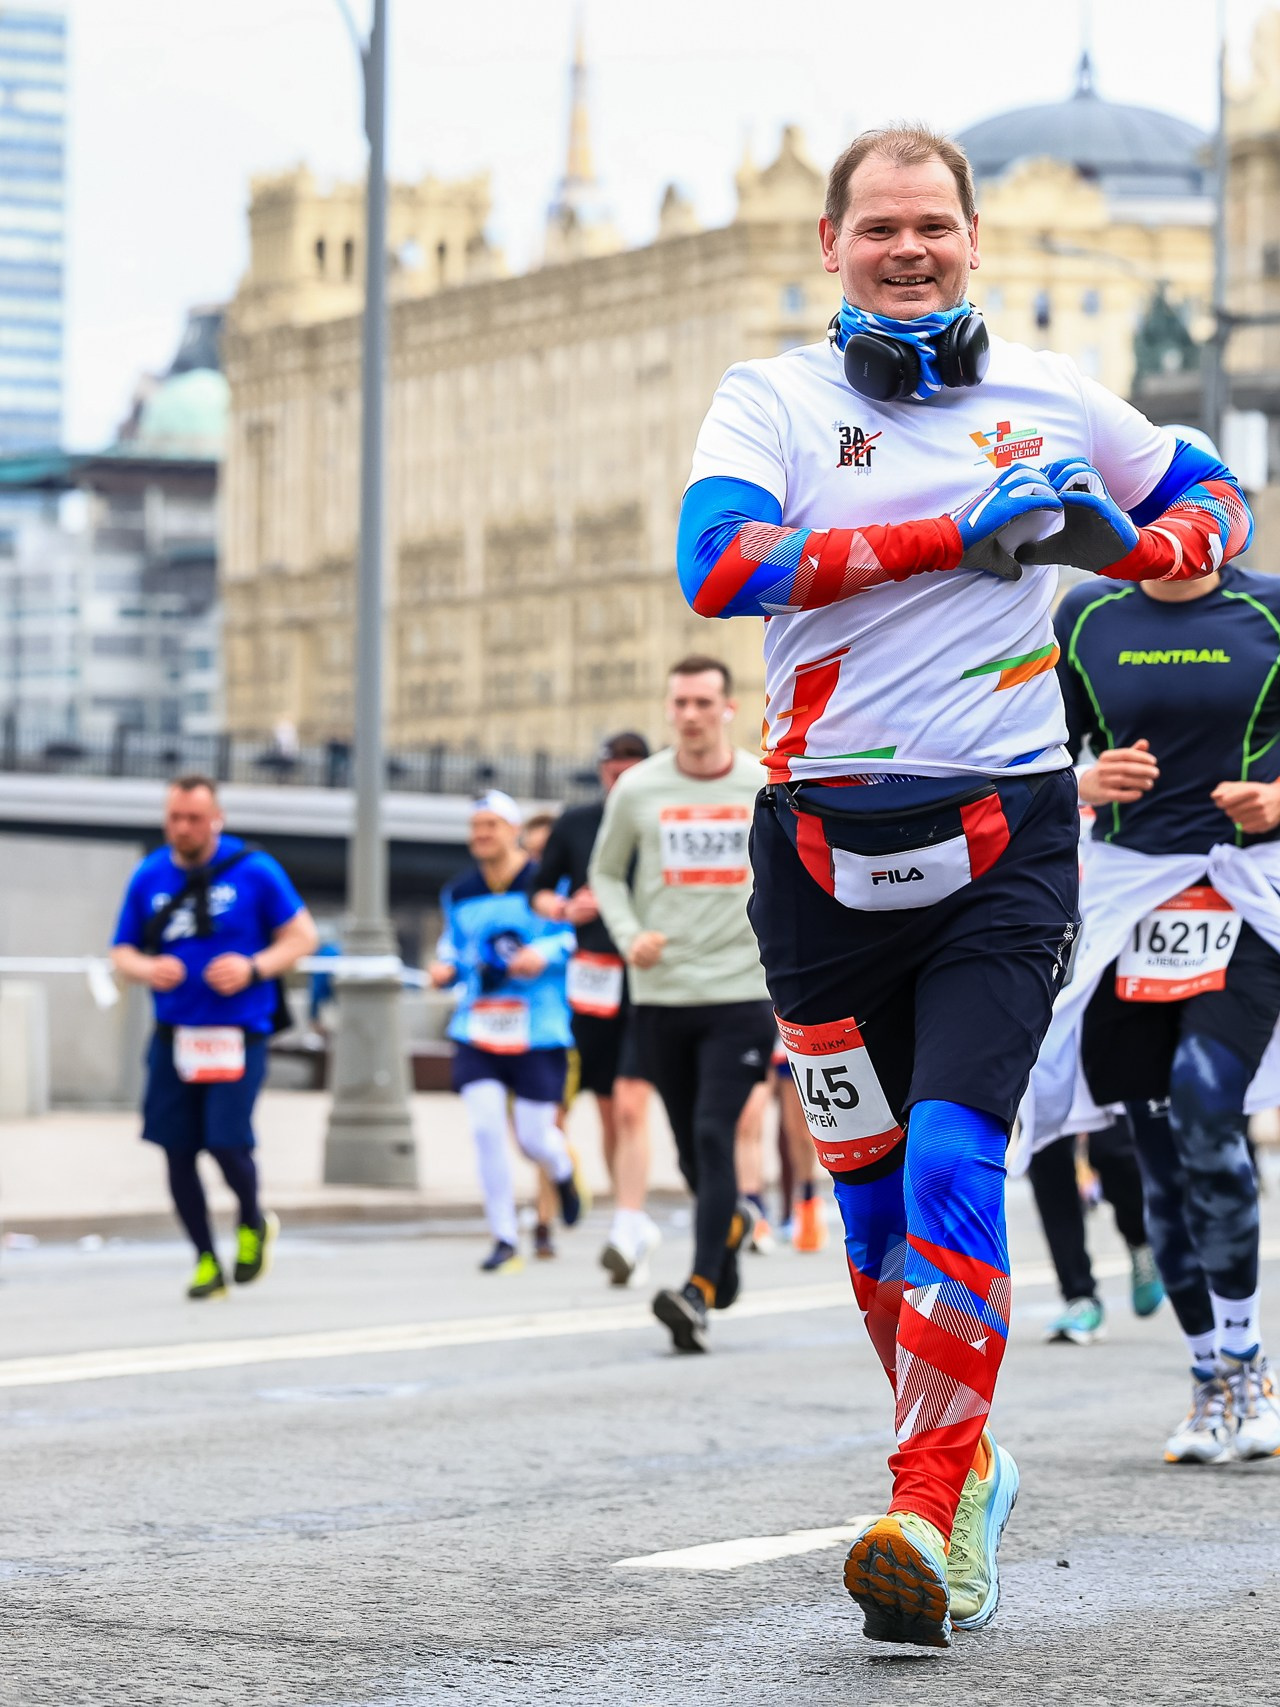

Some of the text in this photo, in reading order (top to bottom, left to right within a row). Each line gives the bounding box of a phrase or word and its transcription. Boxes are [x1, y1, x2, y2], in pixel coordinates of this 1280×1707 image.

[996, 439, 1040, 455] ДОСТИГАЯ
[1011, 447, 1039, 459] ЦЕЛИ!
[1118, 649, 1231, 665] FINNTRAIL
[871, 867, 924, 885] FILA
[1133, 921, 1231, 953] 16216
[804, 1109, 838, 1128] ЕРГЕЙ
